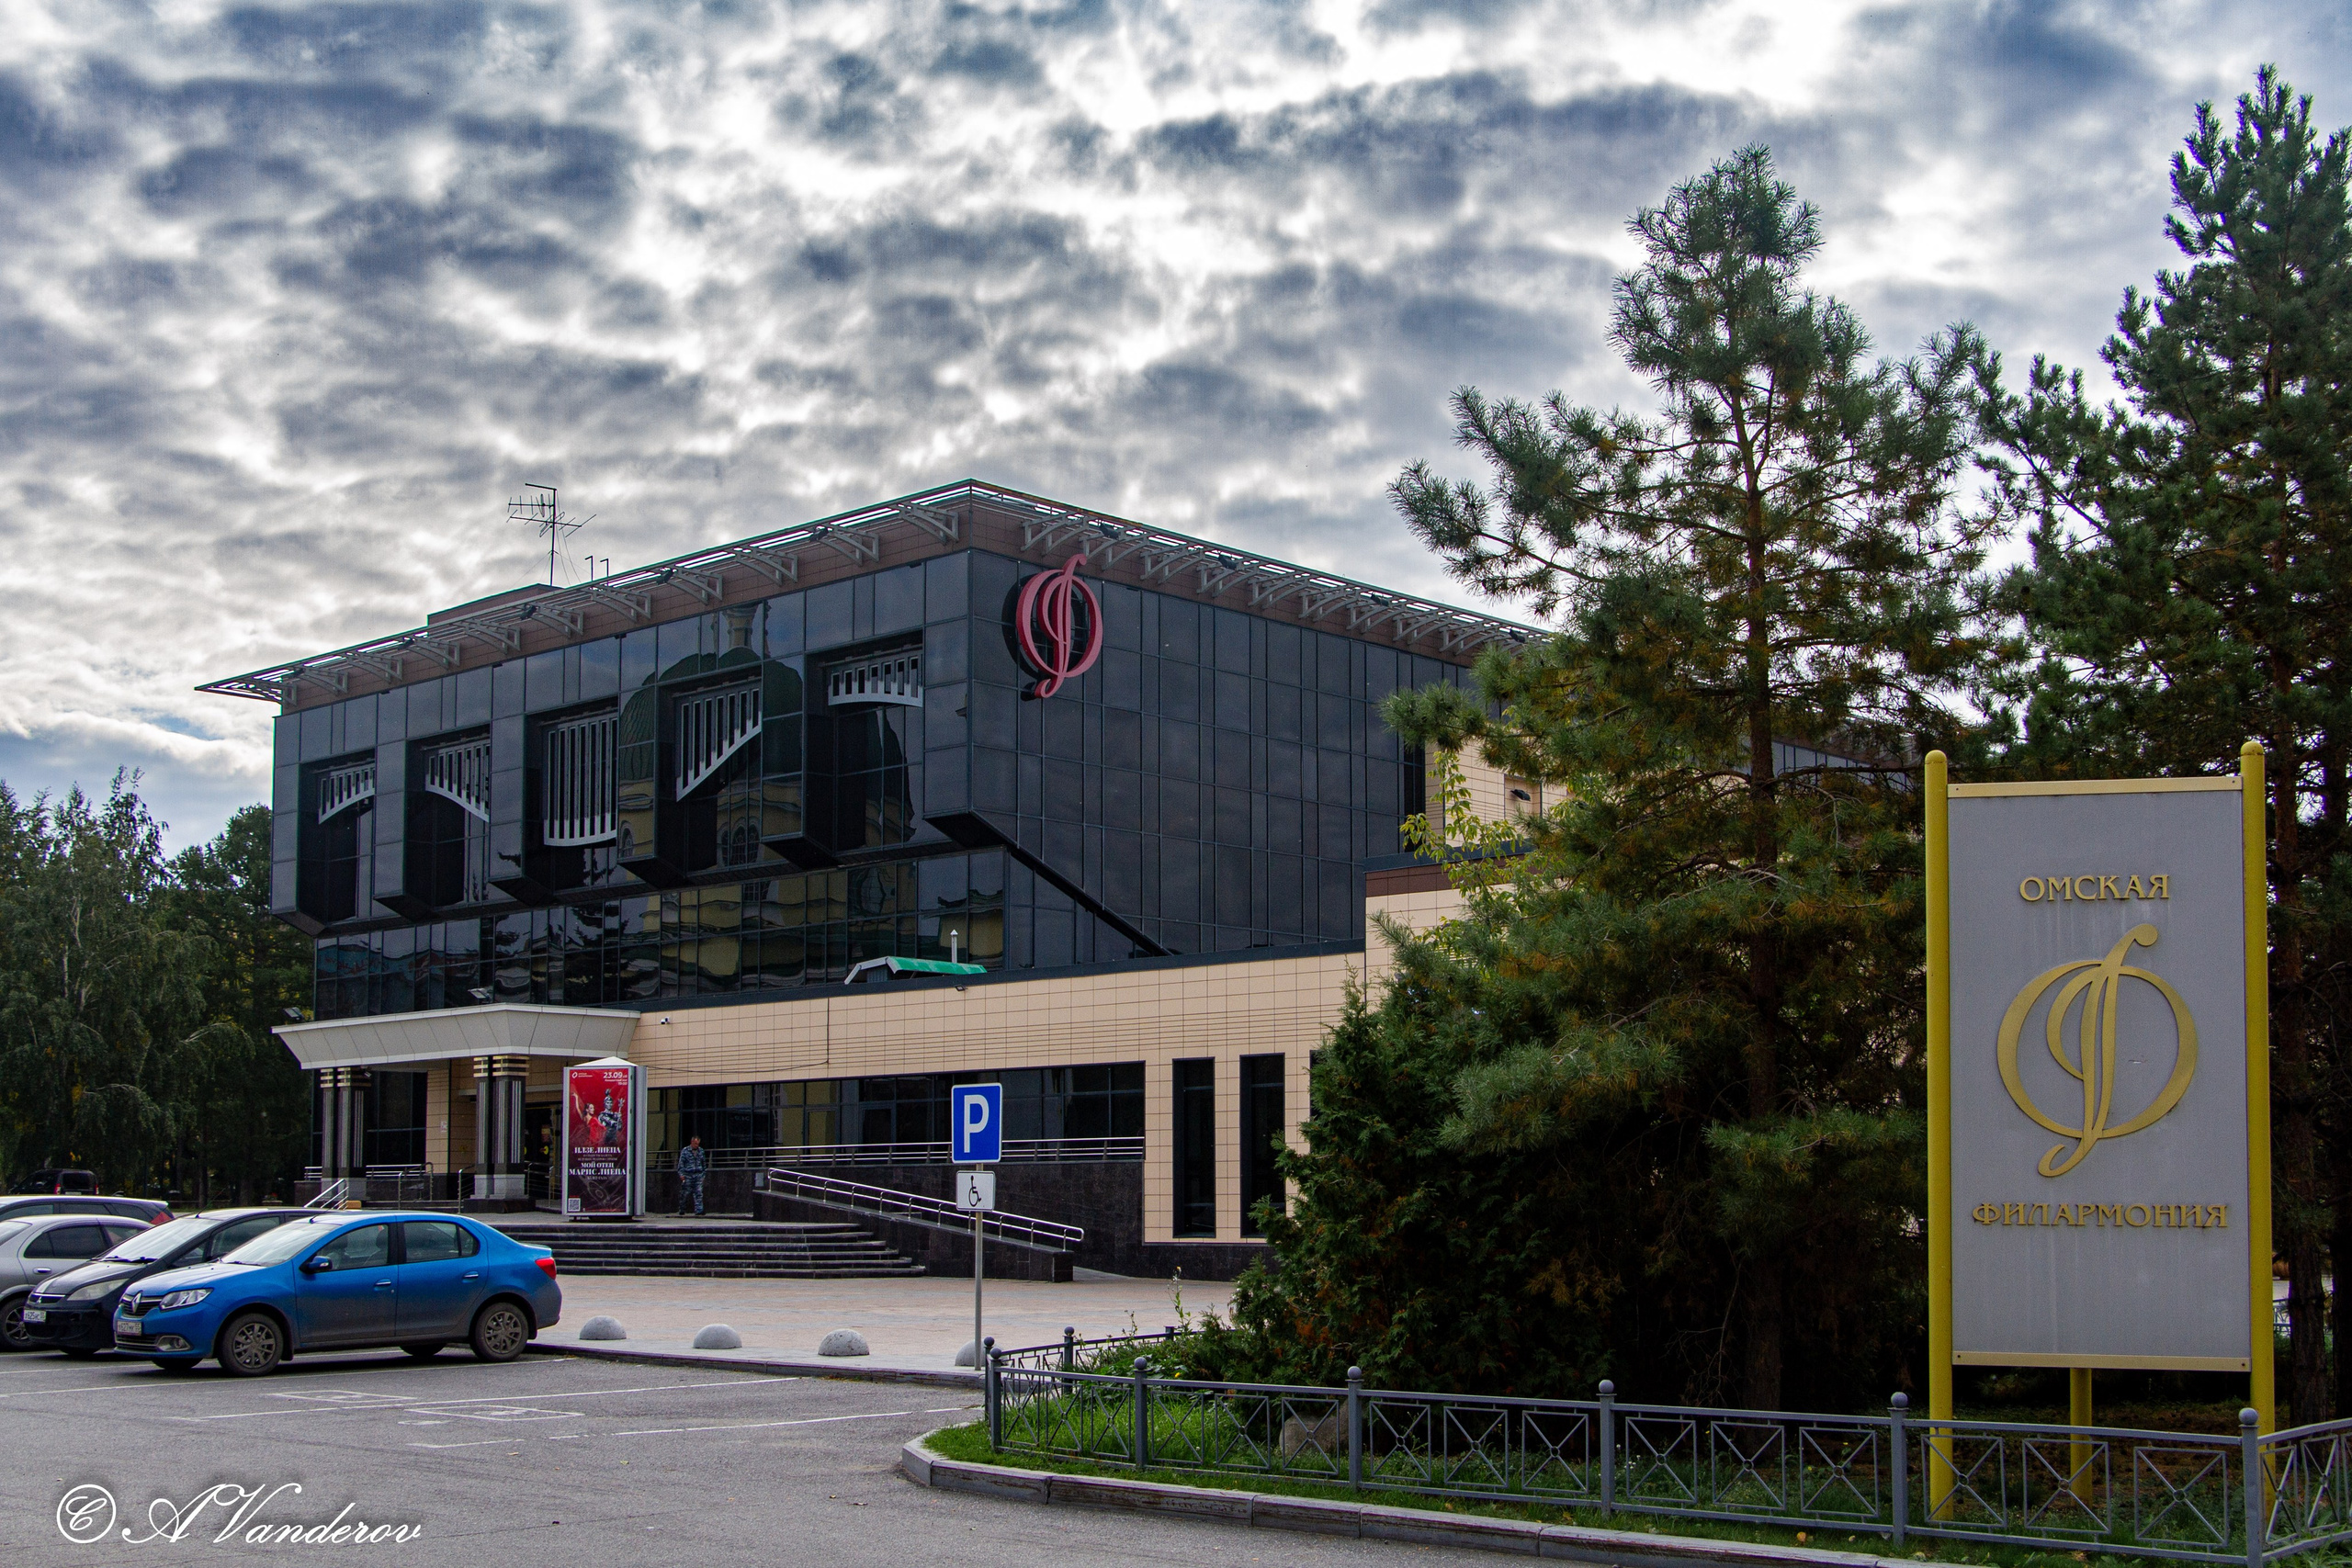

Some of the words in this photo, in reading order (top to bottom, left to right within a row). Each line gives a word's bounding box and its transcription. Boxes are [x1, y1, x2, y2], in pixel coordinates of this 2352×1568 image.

[2019, 874, 2170, 902] ОМСКАЯ
[964, 1094, 989, 1154] P
[1972, 1202, 2228, 1228] ФИЛАРМОНИЯ
